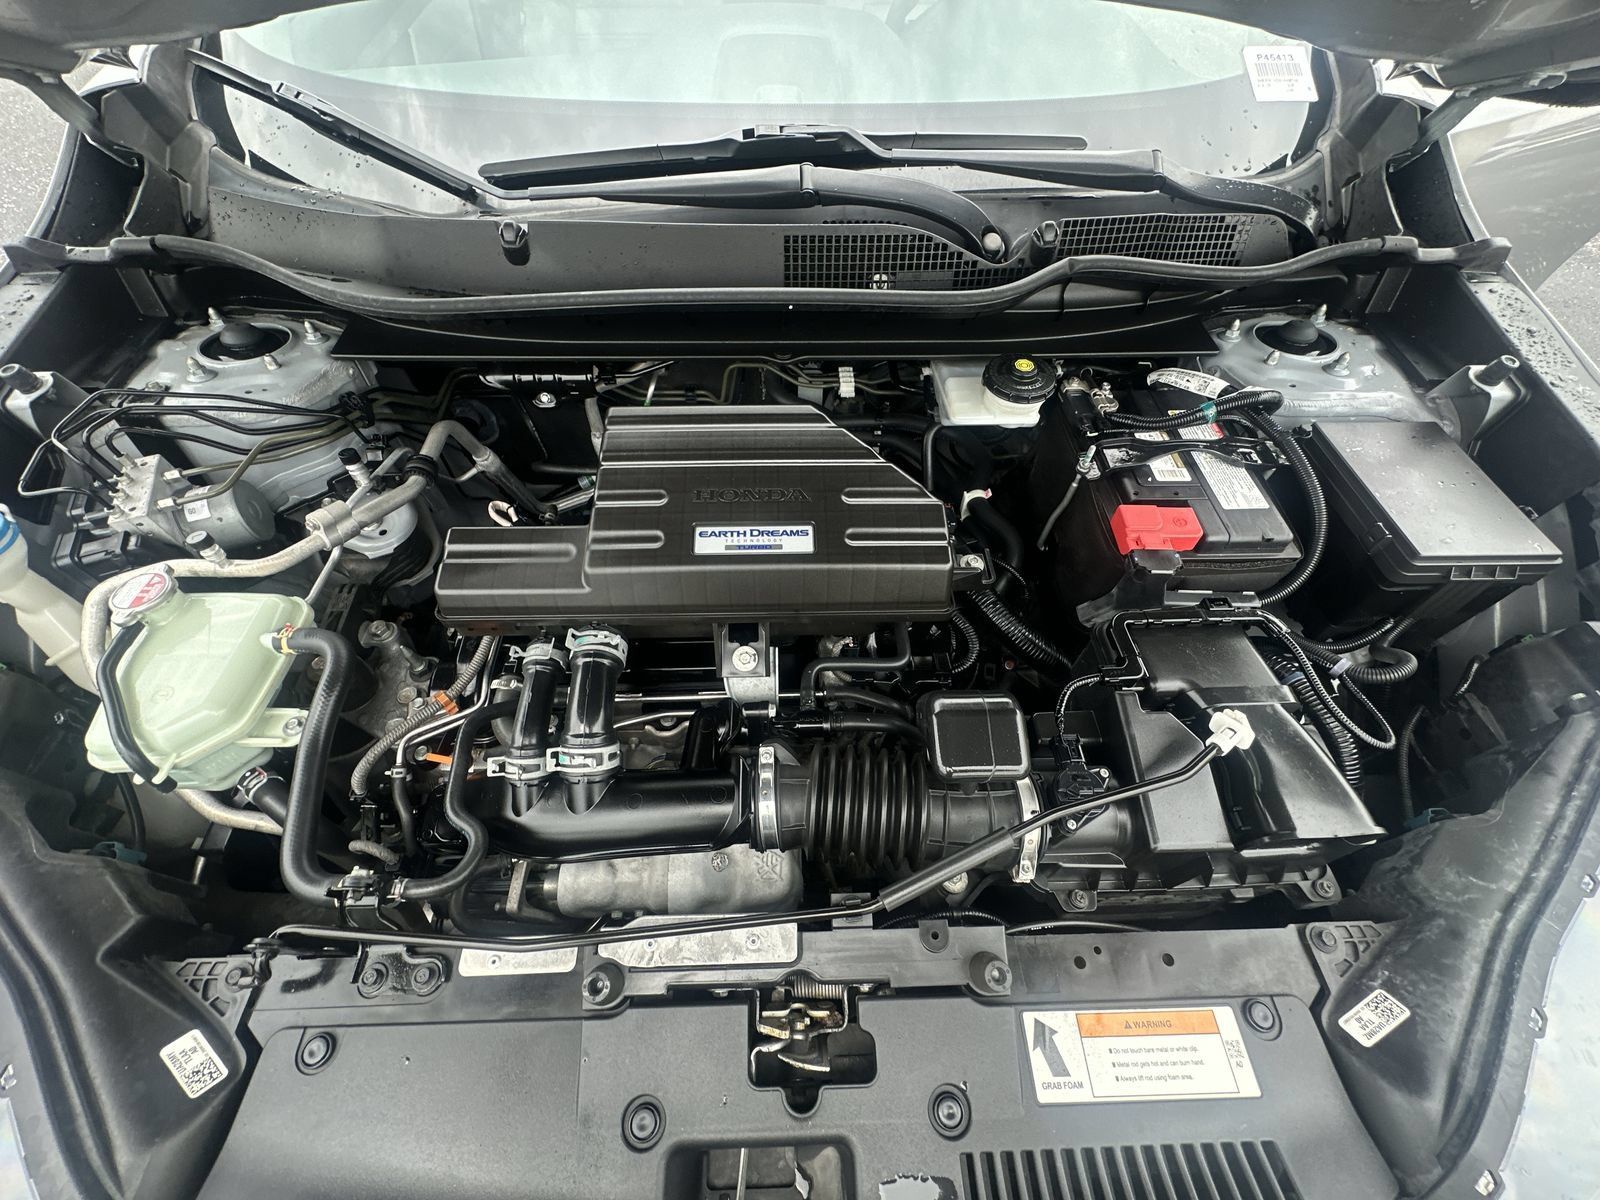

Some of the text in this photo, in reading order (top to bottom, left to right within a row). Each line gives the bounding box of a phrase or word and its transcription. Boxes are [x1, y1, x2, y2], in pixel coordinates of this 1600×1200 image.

[692, 487, 811, 502] HONDA
[698, 528, 810, 538] EARTH DREAMS
[1133, 1019, 1172, 1029] WARNING
[1120, 1075, 1137, 1083] Always
[1041, 1081, 1085, 1091] GRAB FOAM
